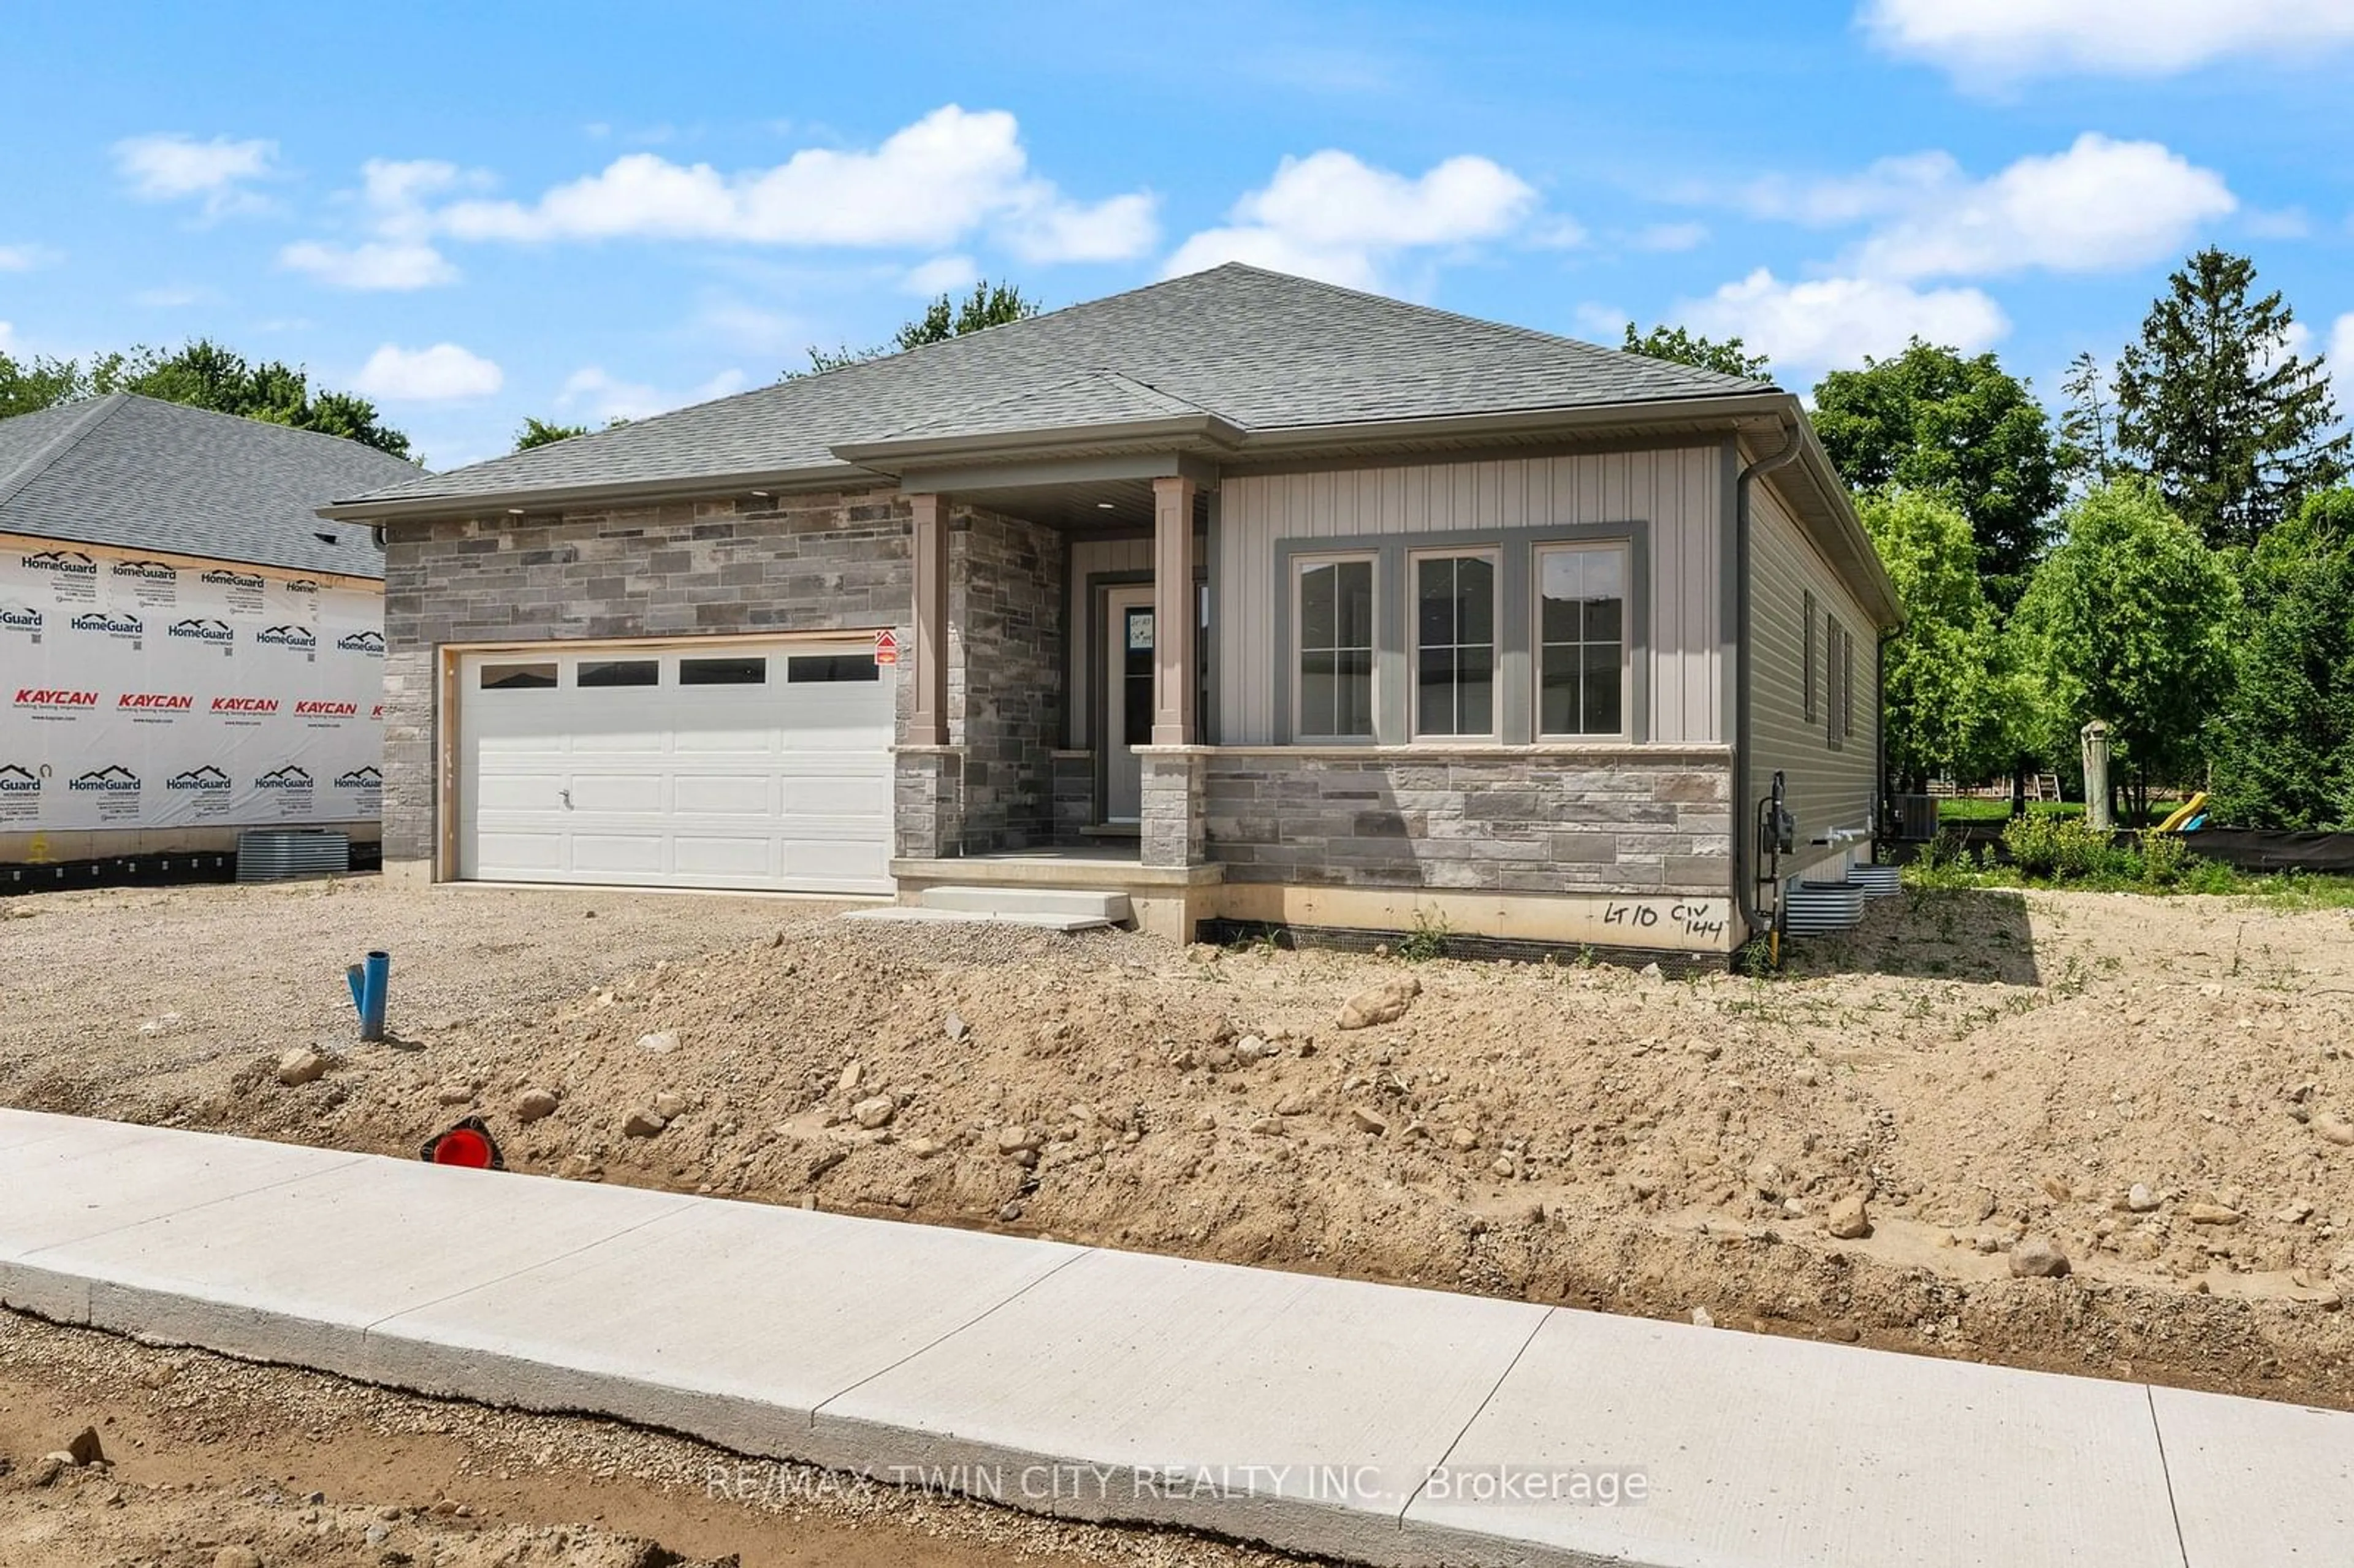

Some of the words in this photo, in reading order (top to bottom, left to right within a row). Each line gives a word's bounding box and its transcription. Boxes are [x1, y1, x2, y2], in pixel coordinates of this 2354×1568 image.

[21, 556, 97, 574] HomeGuard
[201, 574, 265, 588] HomeGuard
[71, 618, 143, 633] HomeGuard
[169, 625, 234, 641] HomeGuard
[257, 633, 316, 647] HomeGuard
[15, 690, 99, 705] KAYCAN
[118, 694, 193, 709] KAYCAN
[211, 698, 279, 711] KAYCAN
[295, 701, 357, 714] KAYCAN
[69, 778, 141, 791] HomeGuard
[166, 778, 231, 790] HomeGuard
[254, 777, 313, 788] HomeGuard
